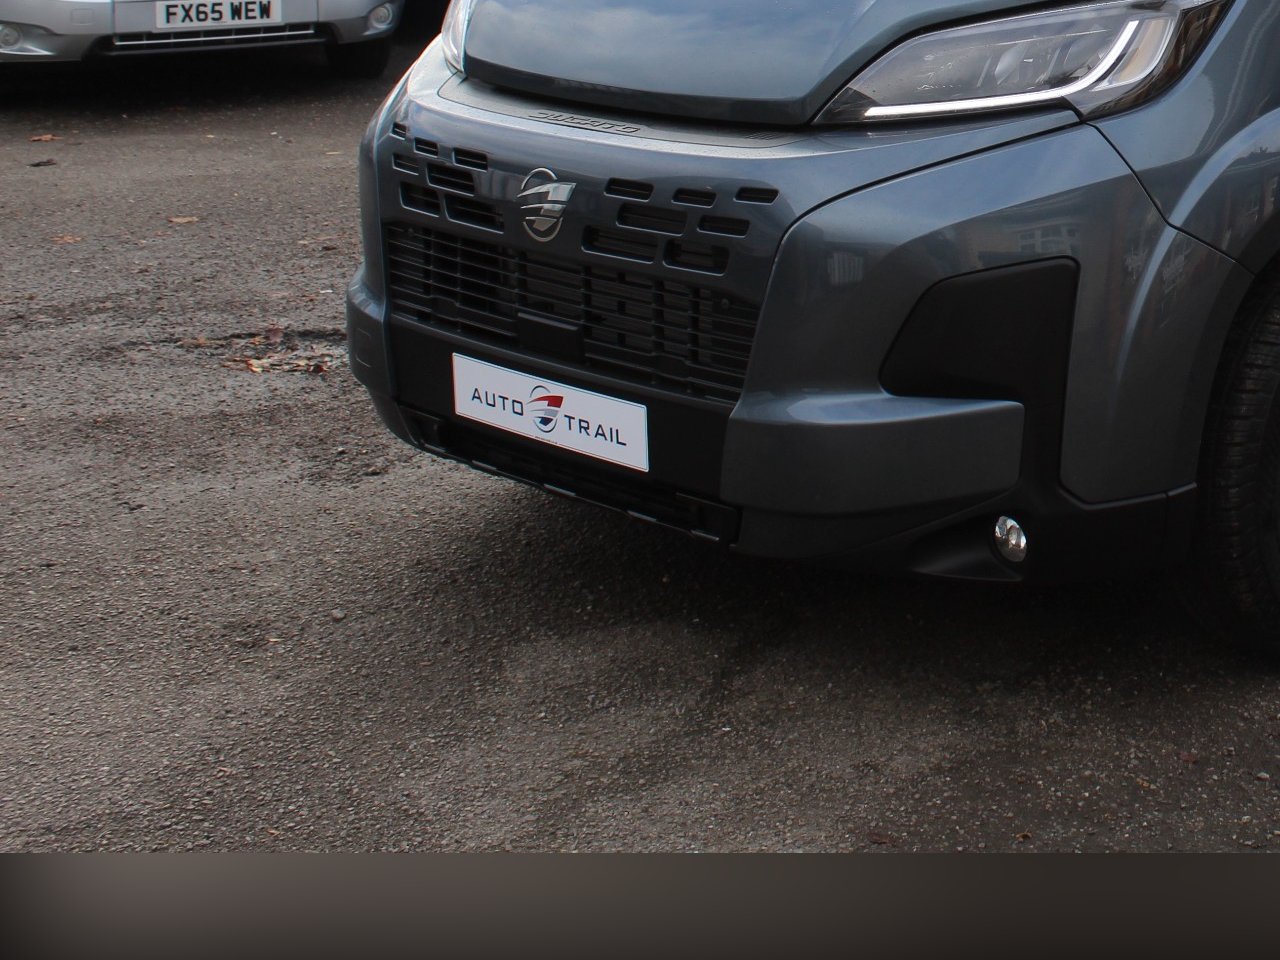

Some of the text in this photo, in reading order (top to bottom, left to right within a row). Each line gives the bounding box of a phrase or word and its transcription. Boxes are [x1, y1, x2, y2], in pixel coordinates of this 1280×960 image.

[165, 0, 271, 24] FX65 WEW
[529, 112, 641, 134] DUCATO
[471, 387, 628, 447] AUTO TRAIL
